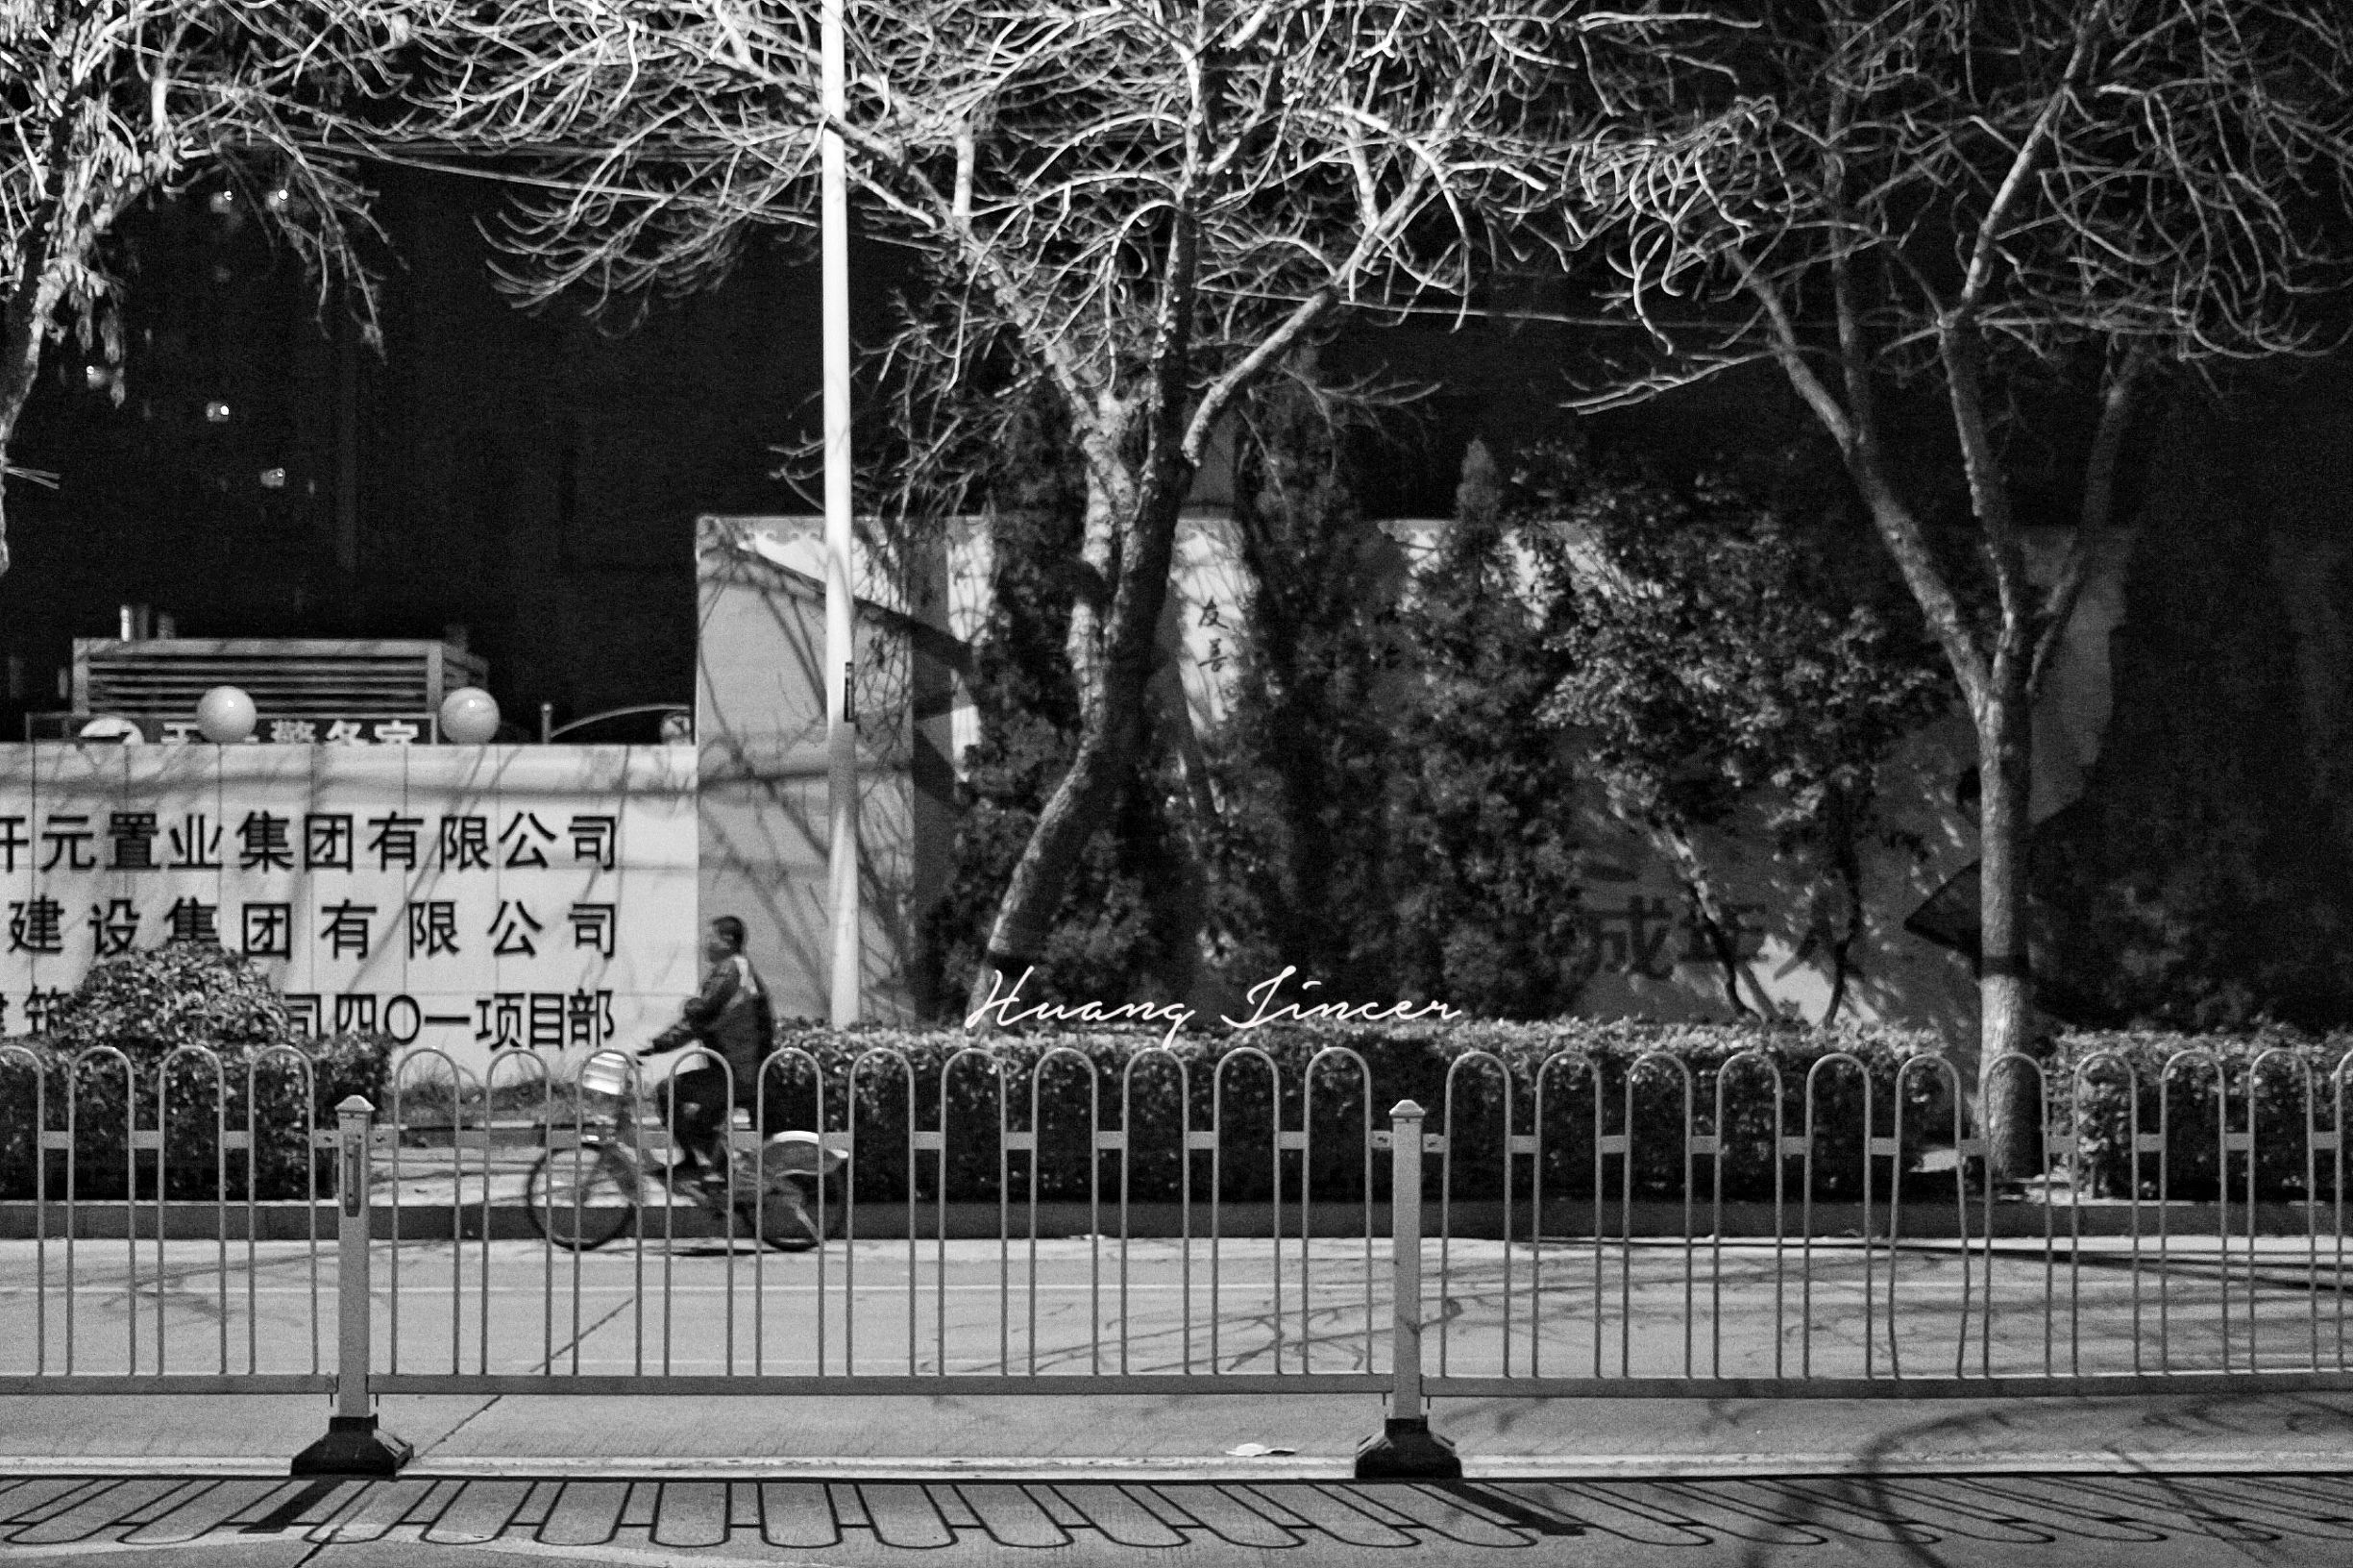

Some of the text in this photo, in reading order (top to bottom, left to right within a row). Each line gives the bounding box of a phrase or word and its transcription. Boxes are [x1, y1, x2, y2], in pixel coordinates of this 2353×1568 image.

[8, 894, 617, 961] 建设集团有限公司
